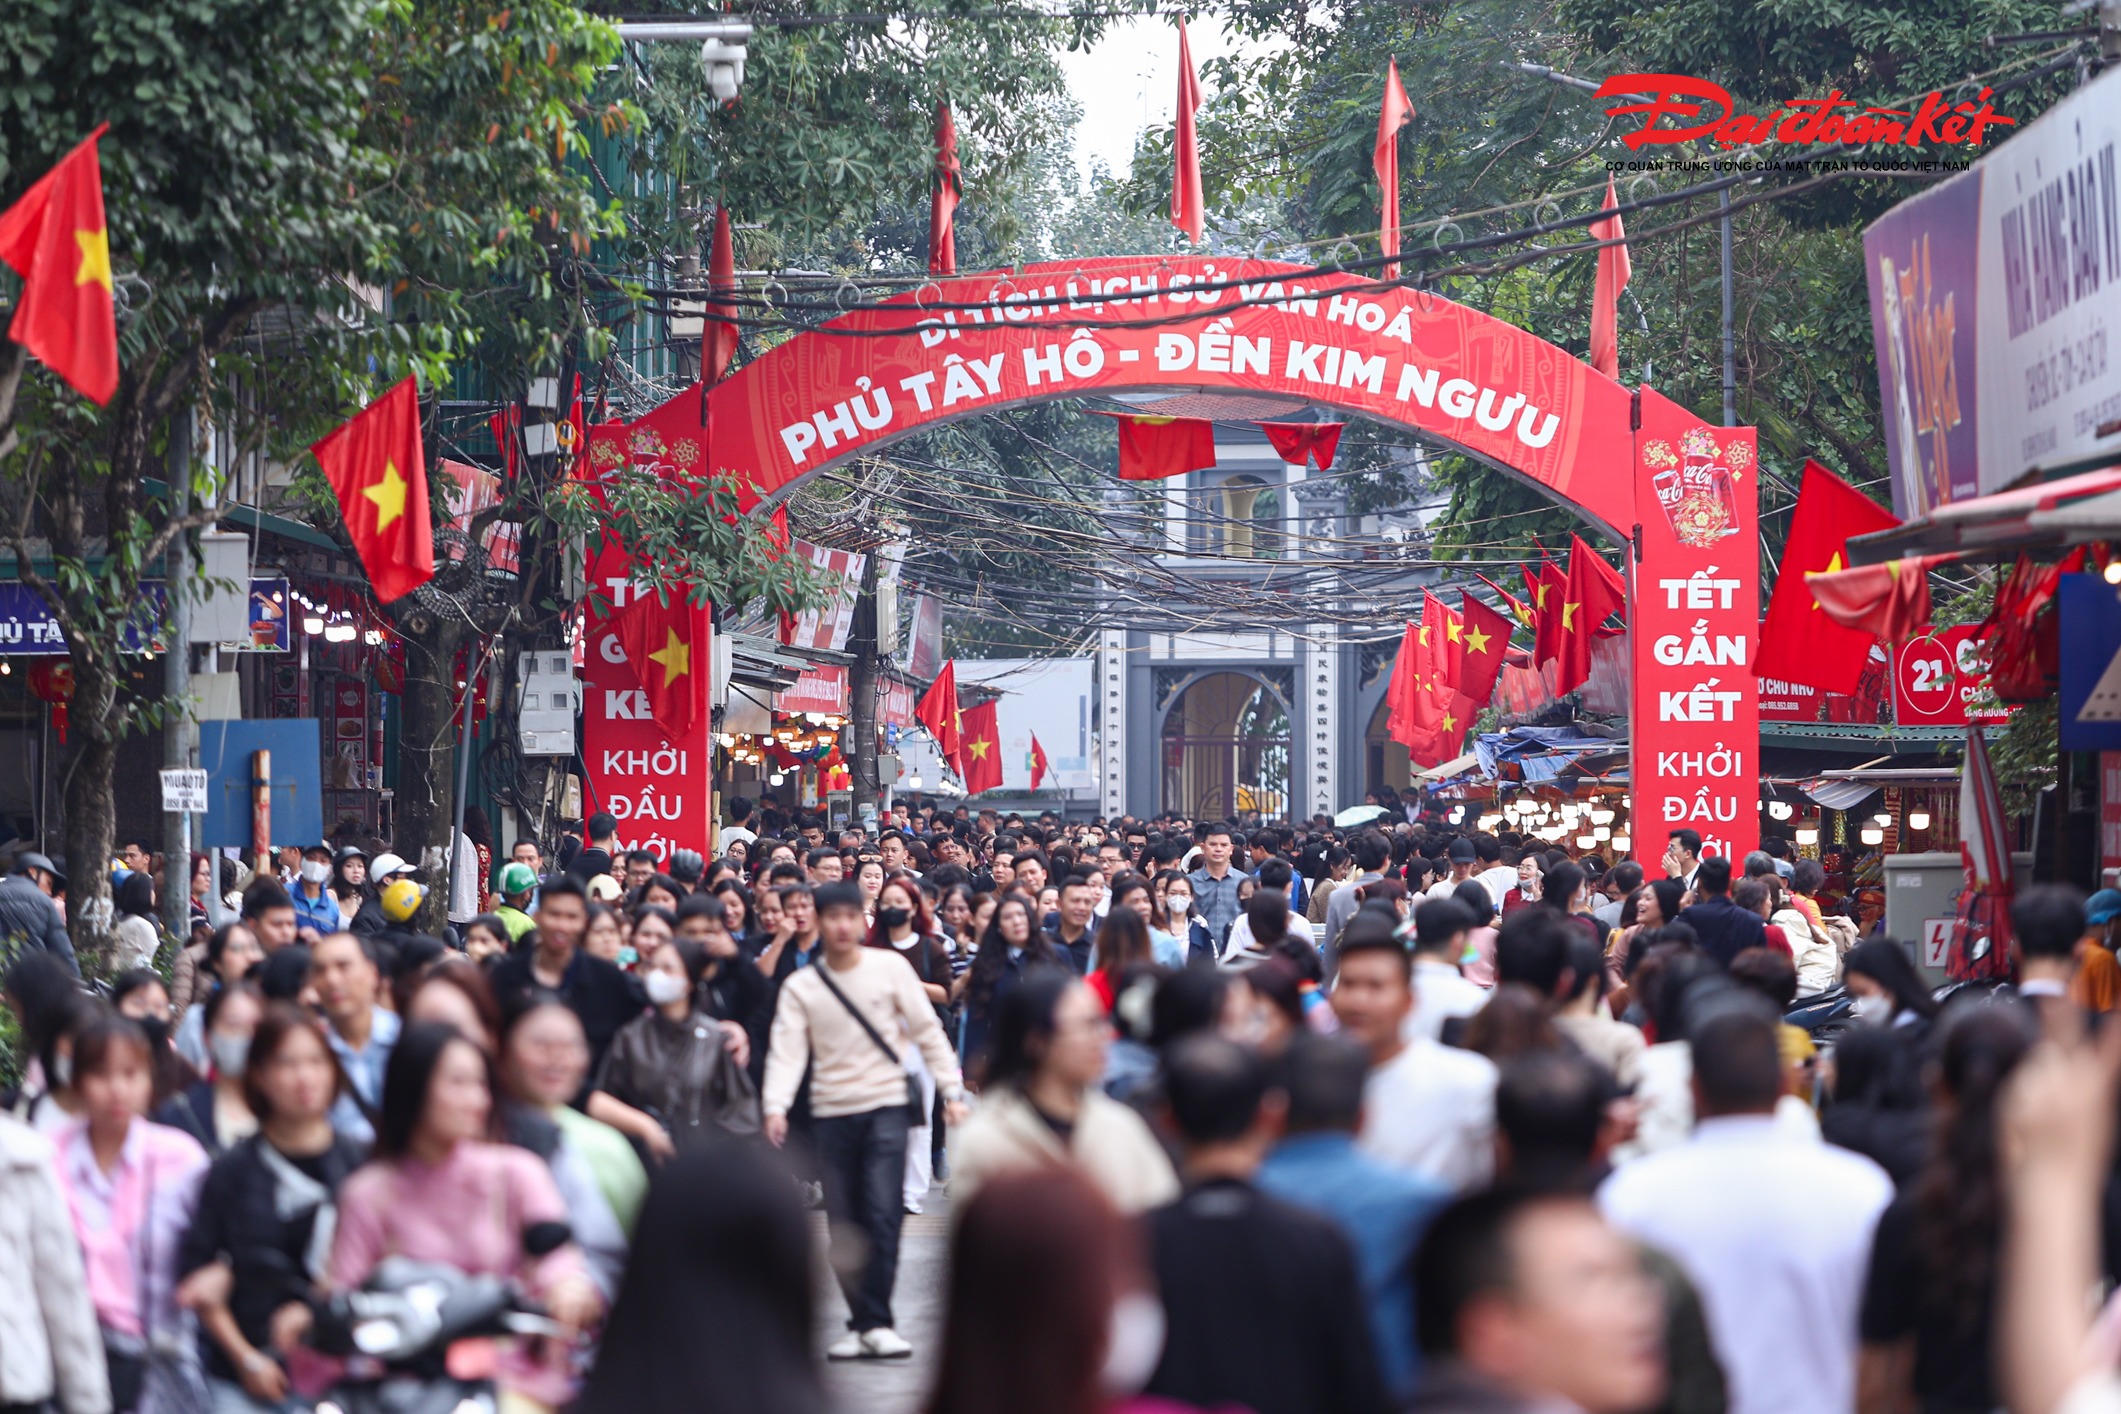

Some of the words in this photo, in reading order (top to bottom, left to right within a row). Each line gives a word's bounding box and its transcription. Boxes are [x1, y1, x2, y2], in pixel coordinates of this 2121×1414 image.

[964, 286, 1060, 323] TÍCH
[1067, 276, 1158, 314] LỊCH
[1168, 264, 1228, 304] SỬ
[1327, 295, 1413, 344] HOÁ
[781, 376, 893, 465] PHỦ
[901, 352, 1005, 412] TÂY
[1120, 350, 1140, 362] -
[1155, 316, 1271, 374] ĐỀN
[1286, 340, 1387, 395] KIM
[1396, 363, 1561, 448] NGƯU
[1659, 565, 1741, 609] TẾT
[1653, 618, 1746, 666] GẮN
[1911, 659, 1945, 692] 21
[1659, 677, 1742, 722] KẾT
[602, 739, 688, 777] KHỞI
[1658, 741, 1741, 777] KHỞI
[606, 783, 683, 821] ĐẦU
[1662, 785, 1738, 822] ĐẦU
